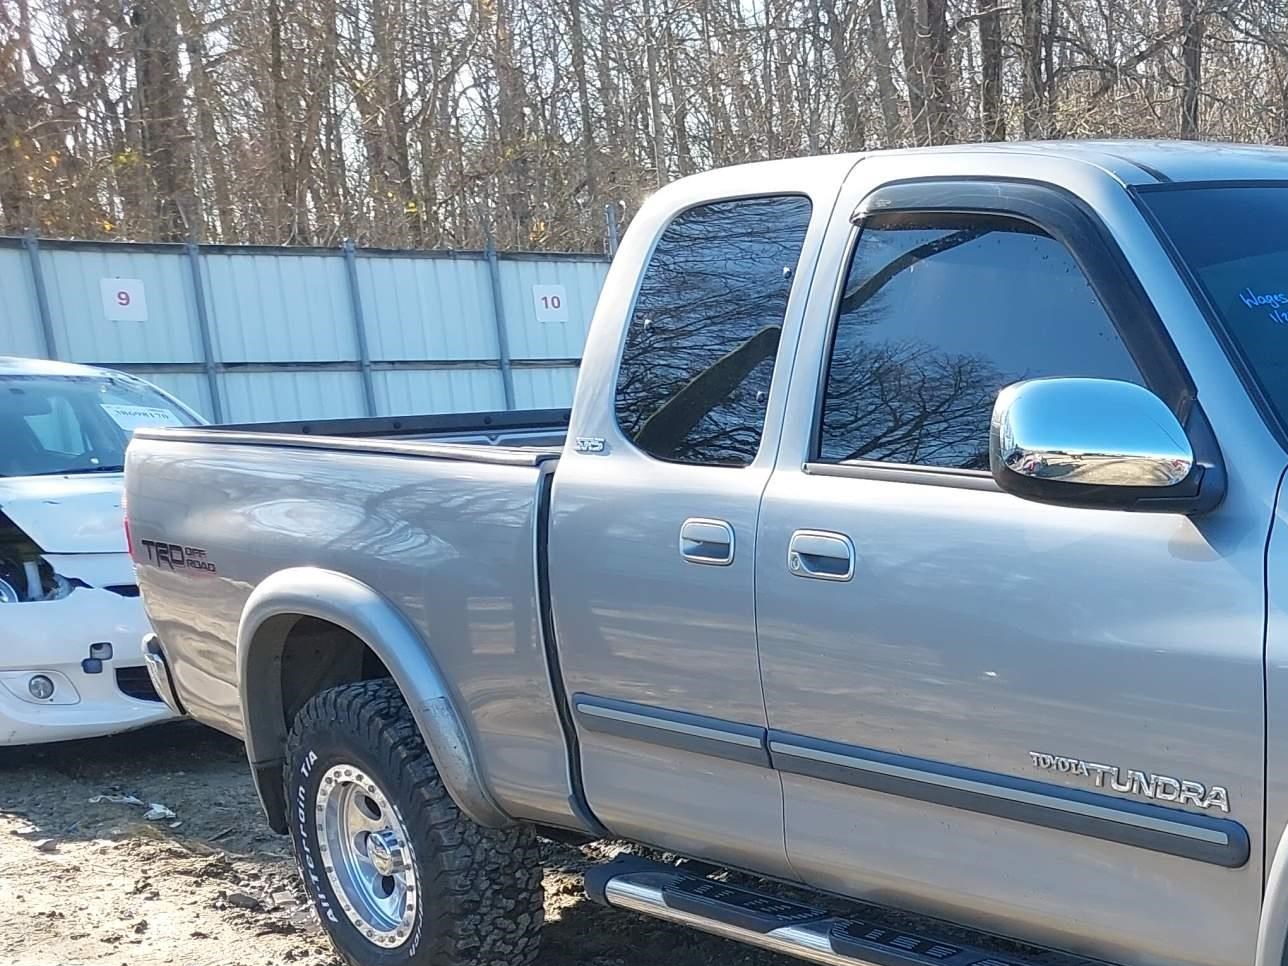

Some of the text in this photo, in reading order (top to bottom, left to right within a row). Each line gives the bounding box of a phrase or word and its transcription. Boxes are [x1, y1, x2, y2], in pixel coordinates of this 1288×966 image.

[117, 291, 130, 306] 9
[541, 295, 561, 309] 10
[141, 540, 185, 571] TRD
[185, 546, 207, 558] OFF
[187, 558, 217, 573] ROAD
[300, 749, 318, 779] T/A
[1029, 751, 1230, 813] TOYOTA TUNDRA
